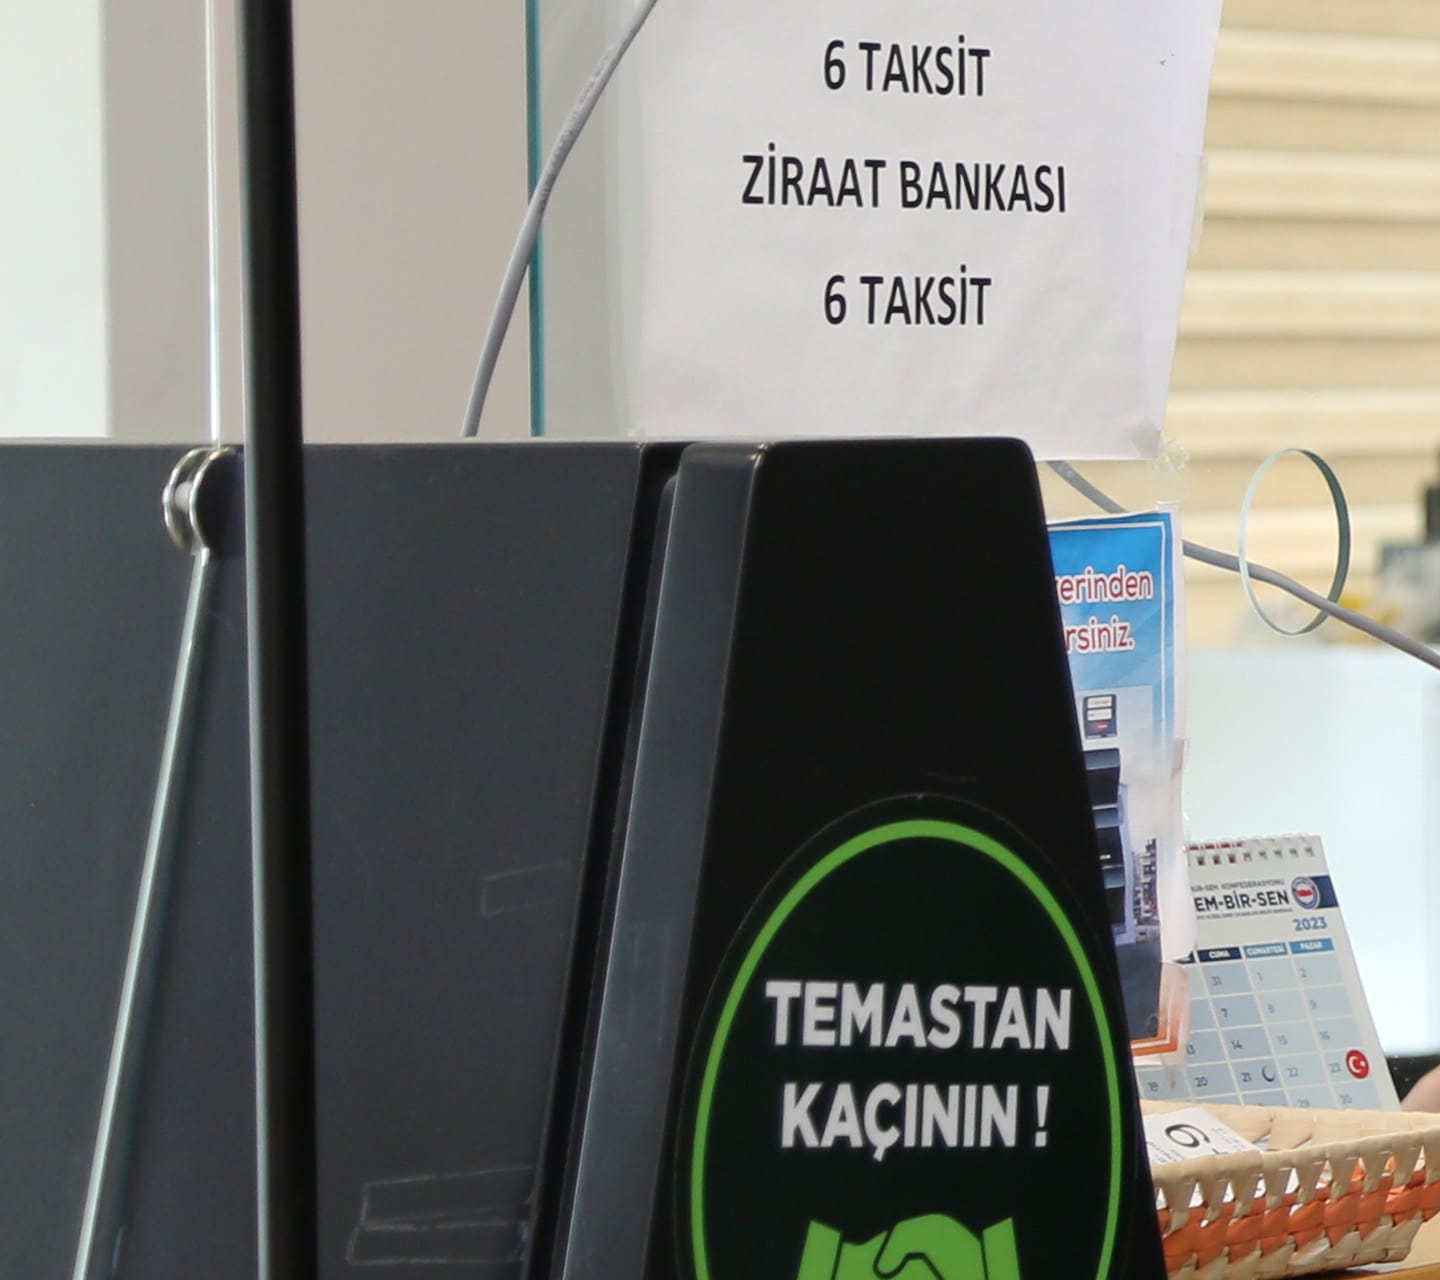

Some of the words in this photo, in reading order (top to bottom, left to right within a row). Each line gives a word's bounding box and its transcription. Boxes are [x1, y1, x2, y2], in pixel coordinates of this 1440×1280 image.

[823, 39, 846, 92] 6
[859, 34, 992, 97] TAKSİT
[741, 142, 886, 208] ZİRAAT
[899, 160, 1067, 213] BANKASI
[823, 274, 846, 326] 6
[860, 265, 992, 326] TAKSİT
[1055, 566, 1153, 602] erinden
[1293, 916, 1327, 931] 2023
[1208, 949, 1231, 959] CUMA
[1300, 939, 1323, 951] PAZAR
[764, 980, 1073, 1050] TEMASTAN
[1221, 1008, 1229, 1018] 7
[1231, 1039, 1243, 1050] 14
[1194, 1076, 1208, 1088] 20
[1240, 1071, 1253, 1083] 21
[780, 1081, 1018, 1161] KAÇININ
[1034, 1085, 1050, 1148] !
